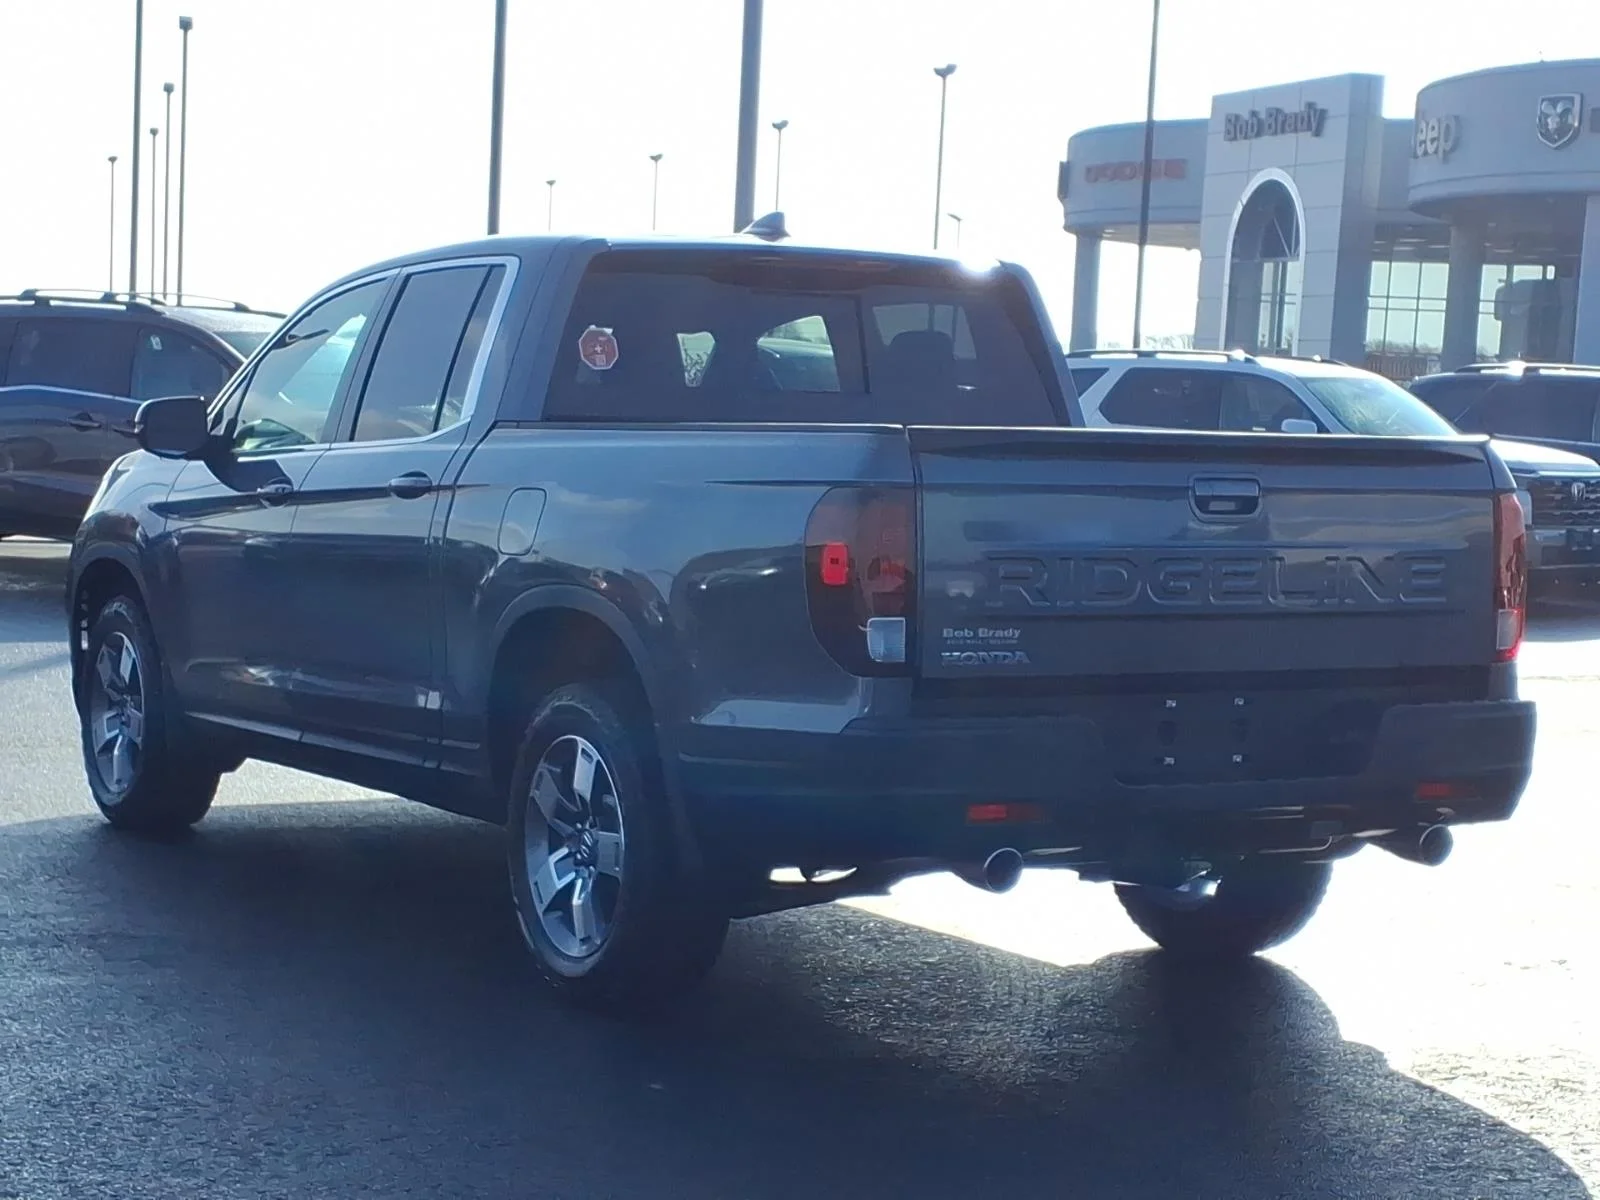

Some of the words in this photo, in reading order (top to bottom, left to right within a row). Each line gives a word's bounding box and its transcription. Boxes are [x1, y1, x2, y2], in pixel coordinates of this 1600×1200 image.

[1223, 109, 1264, 142] Bob
[1264, 101, 1328, 138] Brady
[984, 554, 1449, 608] RIDGELINE
[942, 627, 974, 639] Bob
[977, 627, 1021, 639] Brady
[940, 650, 1031, 665] HONDA
